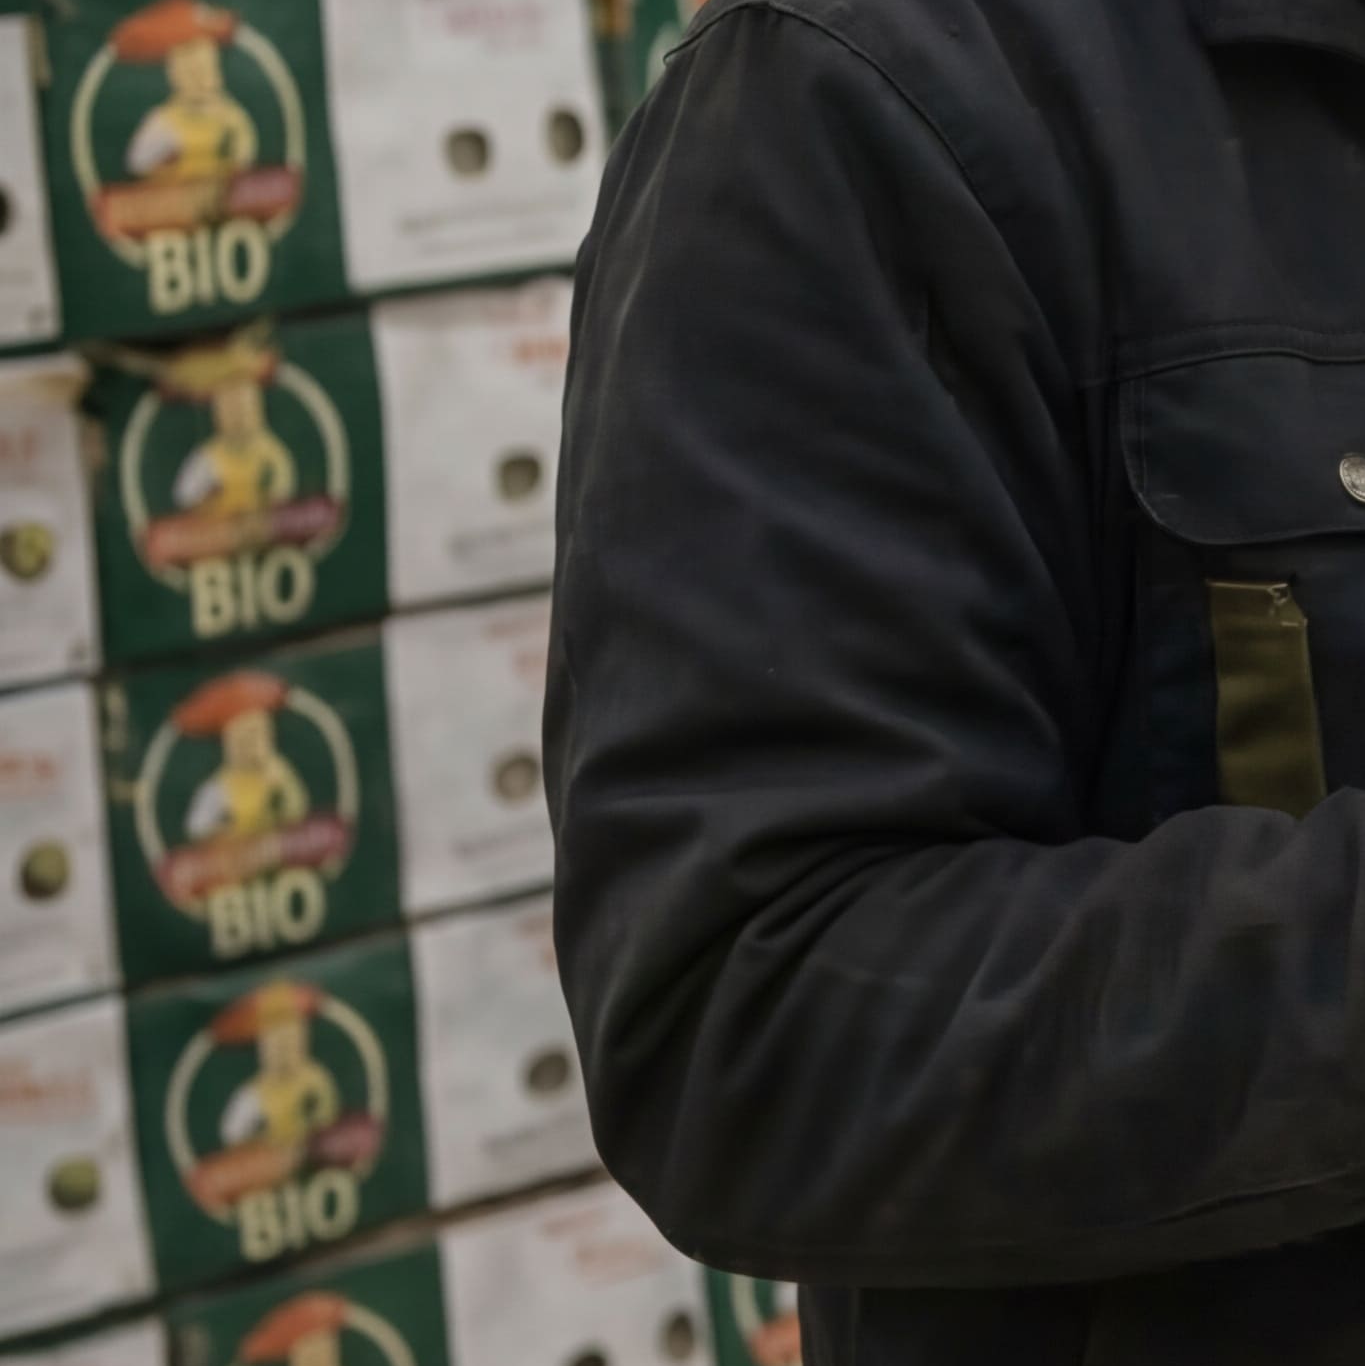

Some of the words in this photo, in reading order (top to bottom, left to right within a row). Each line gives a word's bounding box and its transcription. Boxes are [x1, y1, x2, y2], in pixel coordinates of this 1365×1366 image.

[148, 221, 269, 314] BIO
[190, 549, 316, 637] BIO
[208, 870, 326, 959] BIO
[236, 1172, 360, 1263] BIO
